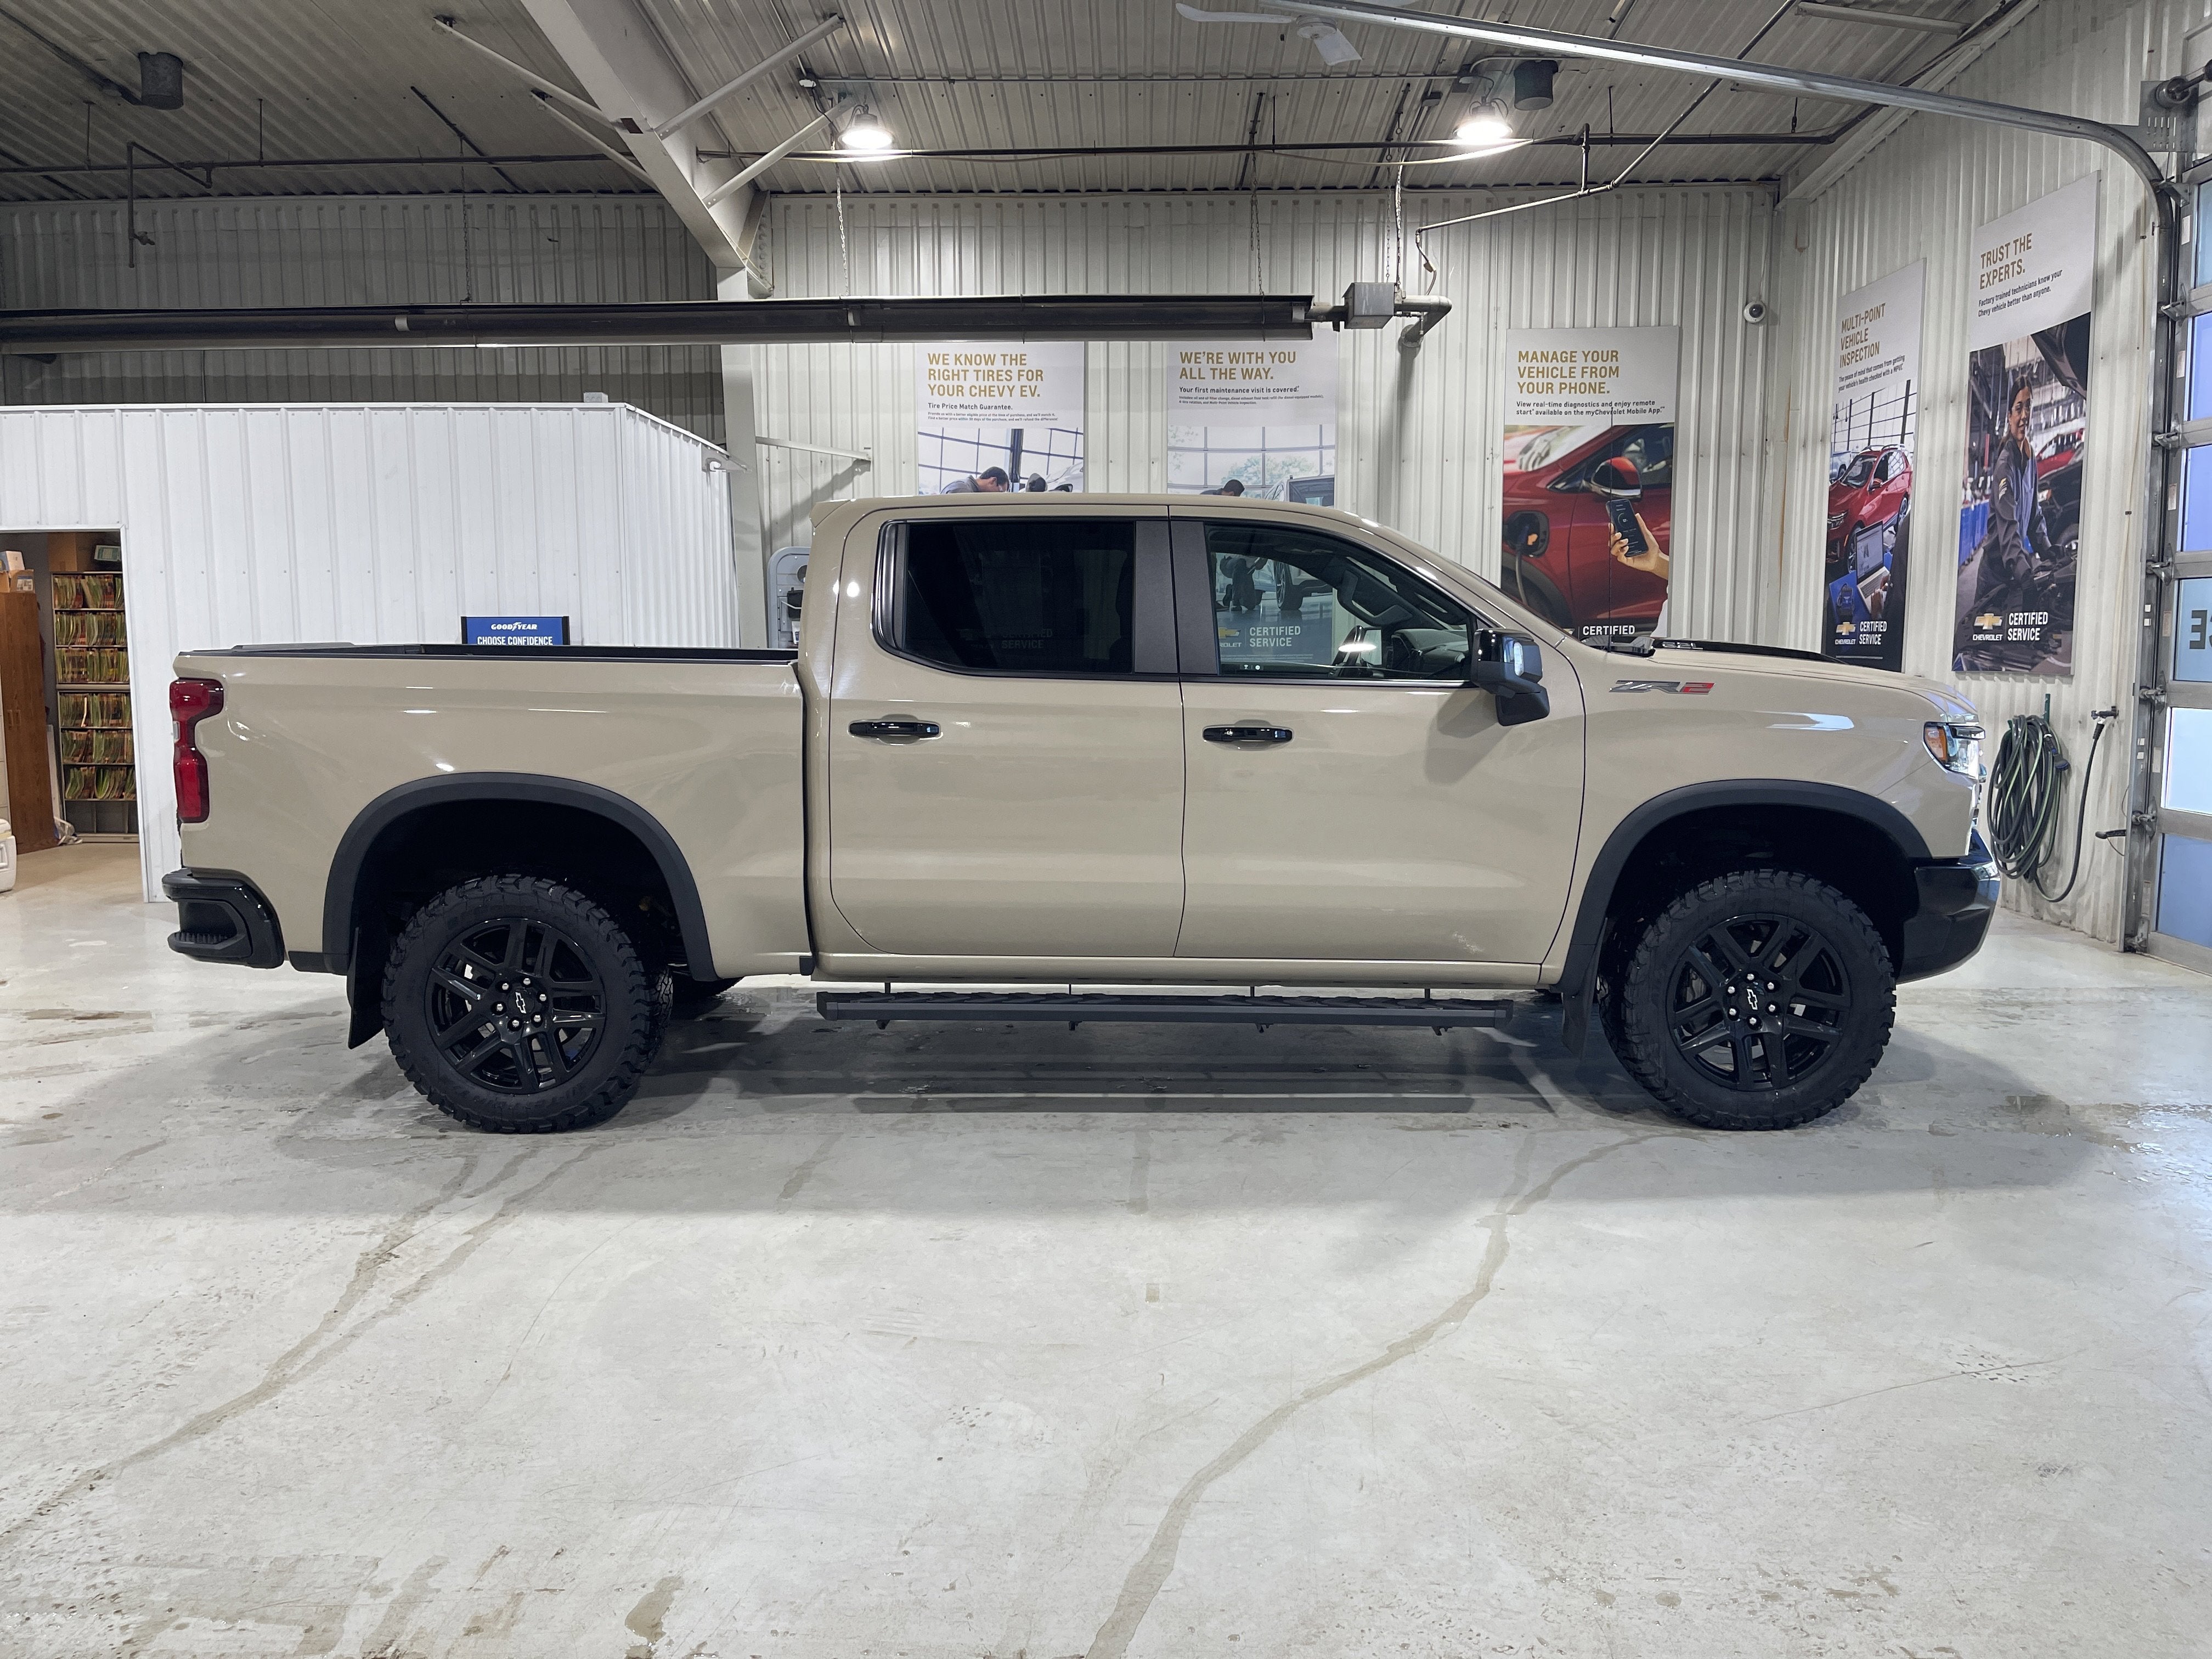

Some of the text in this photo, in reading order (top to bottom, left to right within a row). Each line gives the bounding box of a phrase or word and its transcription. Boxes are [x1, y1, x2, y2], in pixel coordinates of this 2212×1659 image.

[1980, 233, 2032, 269] TRUST THE
[1979, 259, 2025, 290] EXPERTS.
[1978, 270, 2063, 307] Factory trained technicians know your
[1978, 286, 2051, 317] Chevy vehicle better than anyone.
[1841, 303, 1886, 334] MULTI-POINT
[1841, 328, 1869, 351] VEHICLE
[928, 353, 1027, 366] WE KNOW THE
[1180, 351, 1296, 364] WE'RE WITH YOU
[1518, 350, 1618, 363] MANAGE YOUR
[1840, 341, 1880, 368] INSPECTION
[928, 369, 1043, 381] RIGHT TIRES FOR
[1180, 368, 1273, 380] ALL THE WAY.
[1517, 366, 1619, 379] VEHICLE FROM
[928, 384, 1040, 397] YOUR CHEVY EV.
[1517, 382, 1610, 394] YOUR PHONE.
[2009, 612, 2048, 625] CERTIFIED
[491, 622, 538, 631] GOODYEAR
[1250, 626, 1301, 636] CERTIFIED
[1583, 625, 1635, 635] CERTIFIED
[1860, 621, 1887, 632] CERTIFIED
[477, 636, 553, 645] CHOOSE CONFIDENCE
[1859, 634, 1882, 645] SERVICE
[2008, 628, 2041, 641] SERVICE
[1001, 640, 1043, 648] SERVICE
[1250, 637, 1291, 647] SERVICE
[1608, 680, 1715, 695] ZR2
